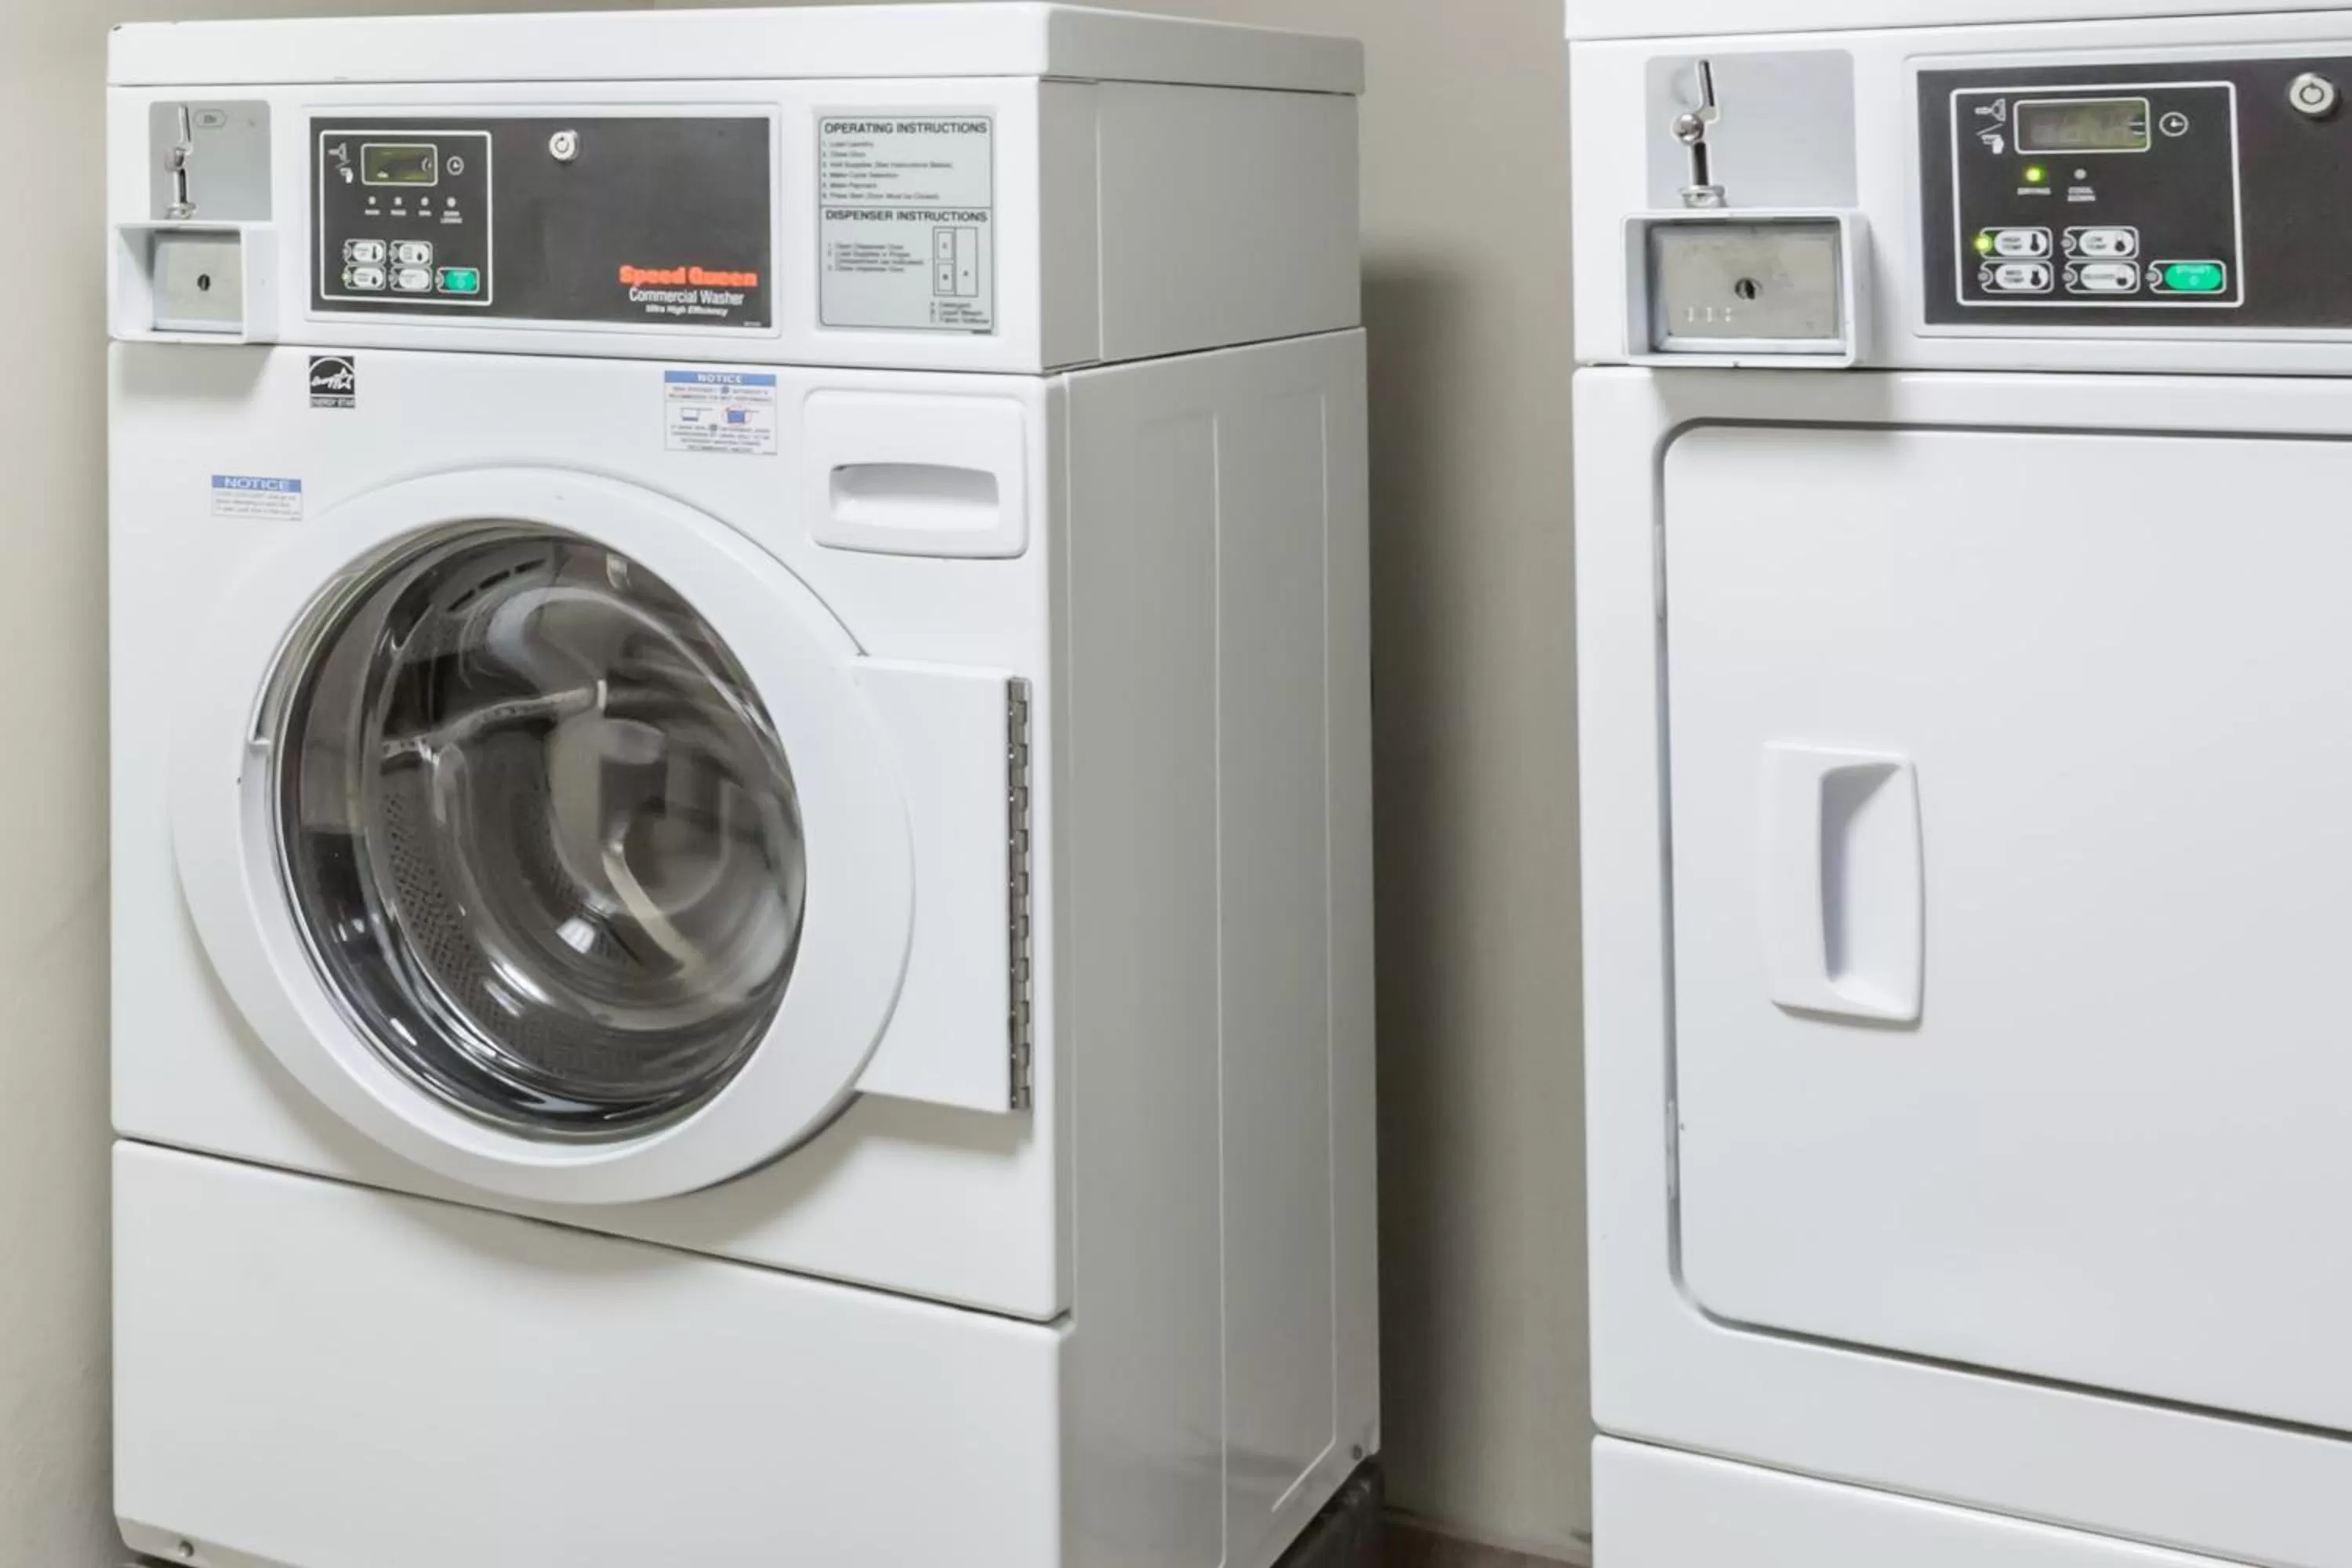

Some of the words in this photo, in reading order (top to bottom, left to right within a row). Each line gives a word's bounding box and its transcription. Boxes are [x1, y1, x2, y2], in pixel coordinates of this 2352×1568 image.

[824, 122, 893, 133] OPERATING
[896, 122, 988, 134] INSTRUCTIONS
[825, 209, 893, 220] DISPENSER
[896, 210, 988, 223] INSTRUCTIONS
[619, 265, 686, 287] Speed
[688, 266, 758, 287] Queen
[629, 288, 698, 303] Commercial
[700, 289, 744, 306] Washer
[224, 477, 289, 492] NOTICE
